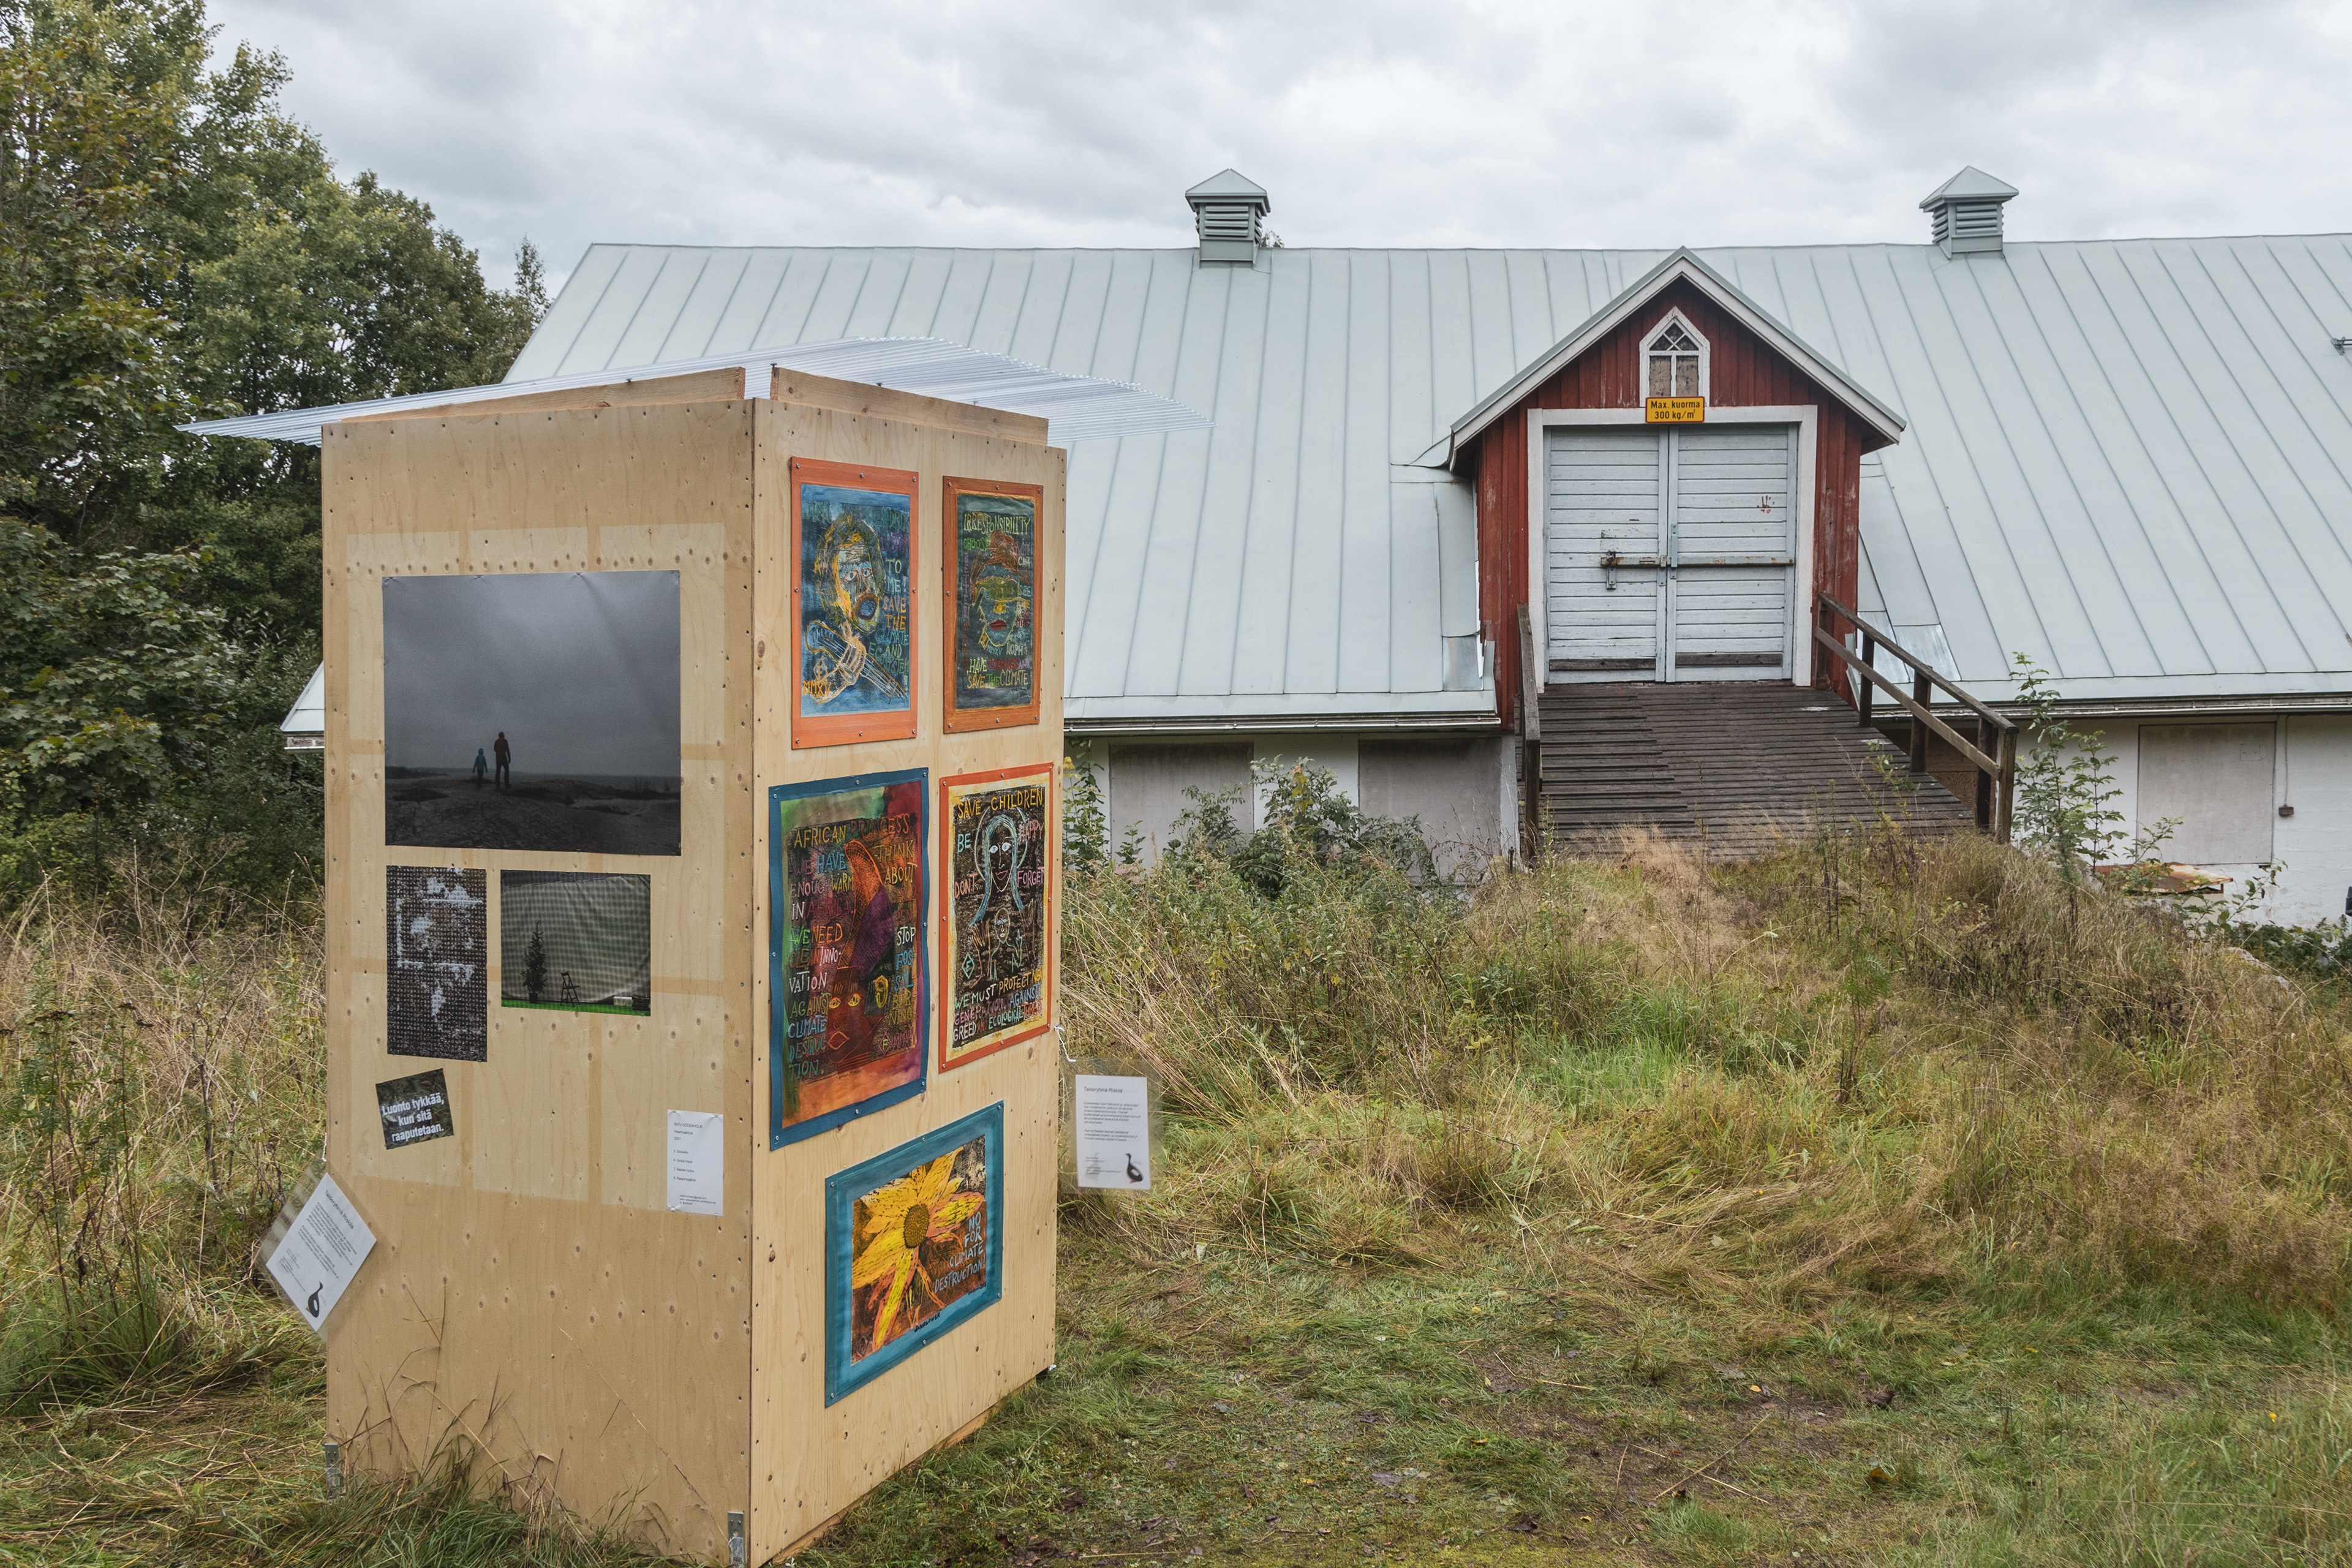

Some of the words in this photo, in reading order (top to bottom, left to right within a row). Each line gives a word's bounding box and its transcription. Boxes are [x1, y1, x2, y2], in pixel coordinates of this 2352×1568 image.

[1651, 400, 1670, 409] Max.
[1672, 400, 1700, 409] kuorma
[963, 511, 1031, 535] IRRESPONSIBILITY
[963, 537, 991, 551] CHOOSE
[886, 559, 902, 574] TO
[1019, 584, 1031, 597] SEE
[883, 595, 907, 613] SAVE
[883, 614, 907, 630] THE
[874, 627, 909, 646] CLIMATE
[885, 643, 902, 658] AND
[987, 658, 1017, 670] COURAGE
[802, 679, 832, 699] MMXV
[967, 674, 986, 689] SAVE
[986, 673, 1000, 685] THE
[1000, 669, 1029, 687] CLIMATE
[957, 799, 982, 819] SAVE
[990, 787, 1042, 811] CHILDREN
[794, 825, 846, 849] AFRICAN
[851, 813, 910, 841] PRINCESS
[957, 832, 971, 853] BE
[1019, 819, 1044, 843] HAPPY
[816, 851, 846, 874] HAVE
[884, 862, 918, 884] ABOUT
[790, 878, 831, 899] ENOUGH
[831, 872, 854, 894] WARM
[954, 872, 979, 899] DONT
[1017, 866, 1045, 888] FORGET
[791, 901, 805, 920] IN
[806, 897, 854, 919] AFRICA.
[791, 925, 810, 945] WE
[811, 922, 843, 944] NEED
[897, 925, 916, 946] STOP
[788, 948, 820, 968] CLEAN
[788, 970, 827, 993] VATION
[894, 971, 914, 992] SIL
[954, 993, 970, 1009] WE
[971, 983, 997, 1005] MUST
[998, 971, 1032, 997] PROTECT
[790, 992, 831, 1019] AGAINST
[1009, 981, 1041, 1009] AGAINST
[788, 1014, 827, 1038] CLIMATE
[953, 1020, 978, 1041] GREED
[988, 1005, 1023, 1030] ECOLOGICAL
[1021, 998, 1043, 1020] THREAT
[881, 1039, 888, 1050] F
[788, 1059, 824, 1082] TION.
[382, 1101, 411, 1116] Luonto
[411, 1091, 445, 1111] tykkää,
[398, 1114, 415, 1126] kun
[417, 1109, 433, 1123] sitä
[391, 1123, 445, 1142] raaputetaan.
[968, 1211, 982, 1232] NO
[963, 1226, 982, 1248] FOR
[949, 1240, 984, 1268] CLIMATE
[934, 1254, 986, 1294] DESTRUCTION!
